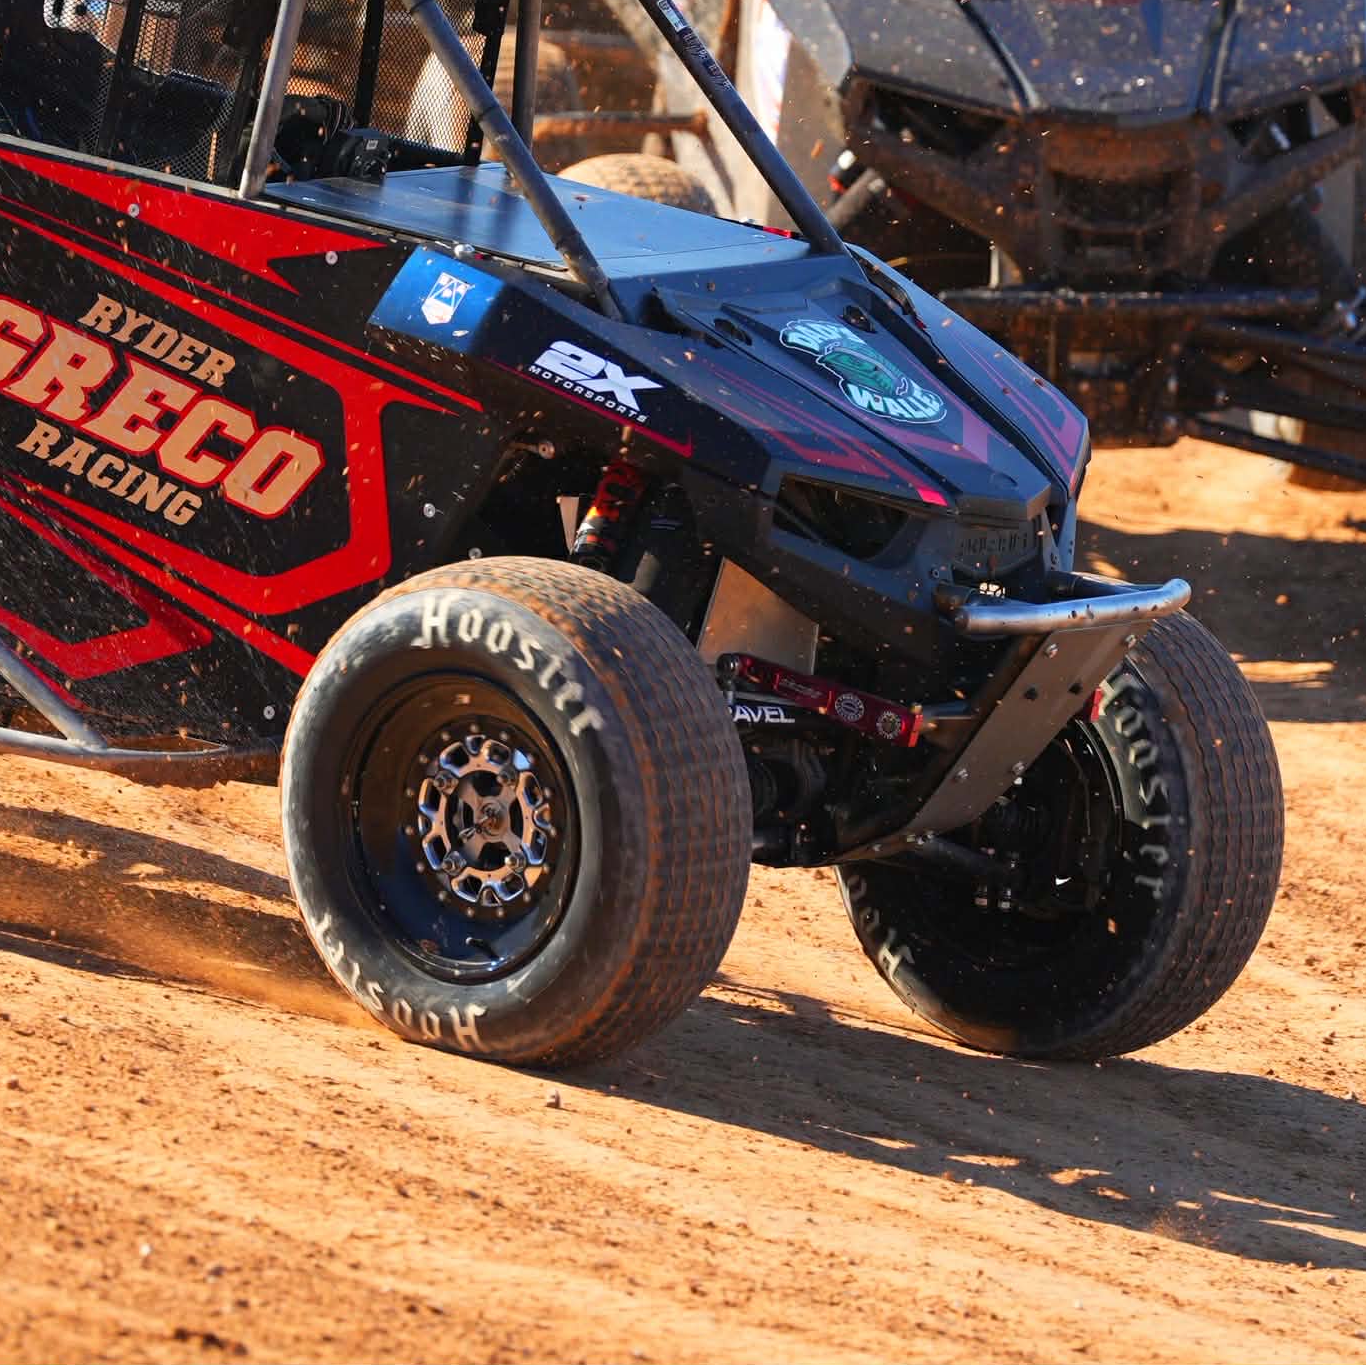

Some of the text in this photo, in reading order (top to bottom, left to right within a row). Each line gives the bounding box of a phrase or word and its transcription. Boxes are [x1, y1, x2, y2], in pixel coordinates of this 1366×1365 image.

[78, 293, 236, 388] RYDER
[528, 365, 648, 423] MOTORSPORTS
[16, 419, 204, 528] RACING
[410, 593, 604, 736] Hoosier
[729, 705, 795, 723] AVEL
